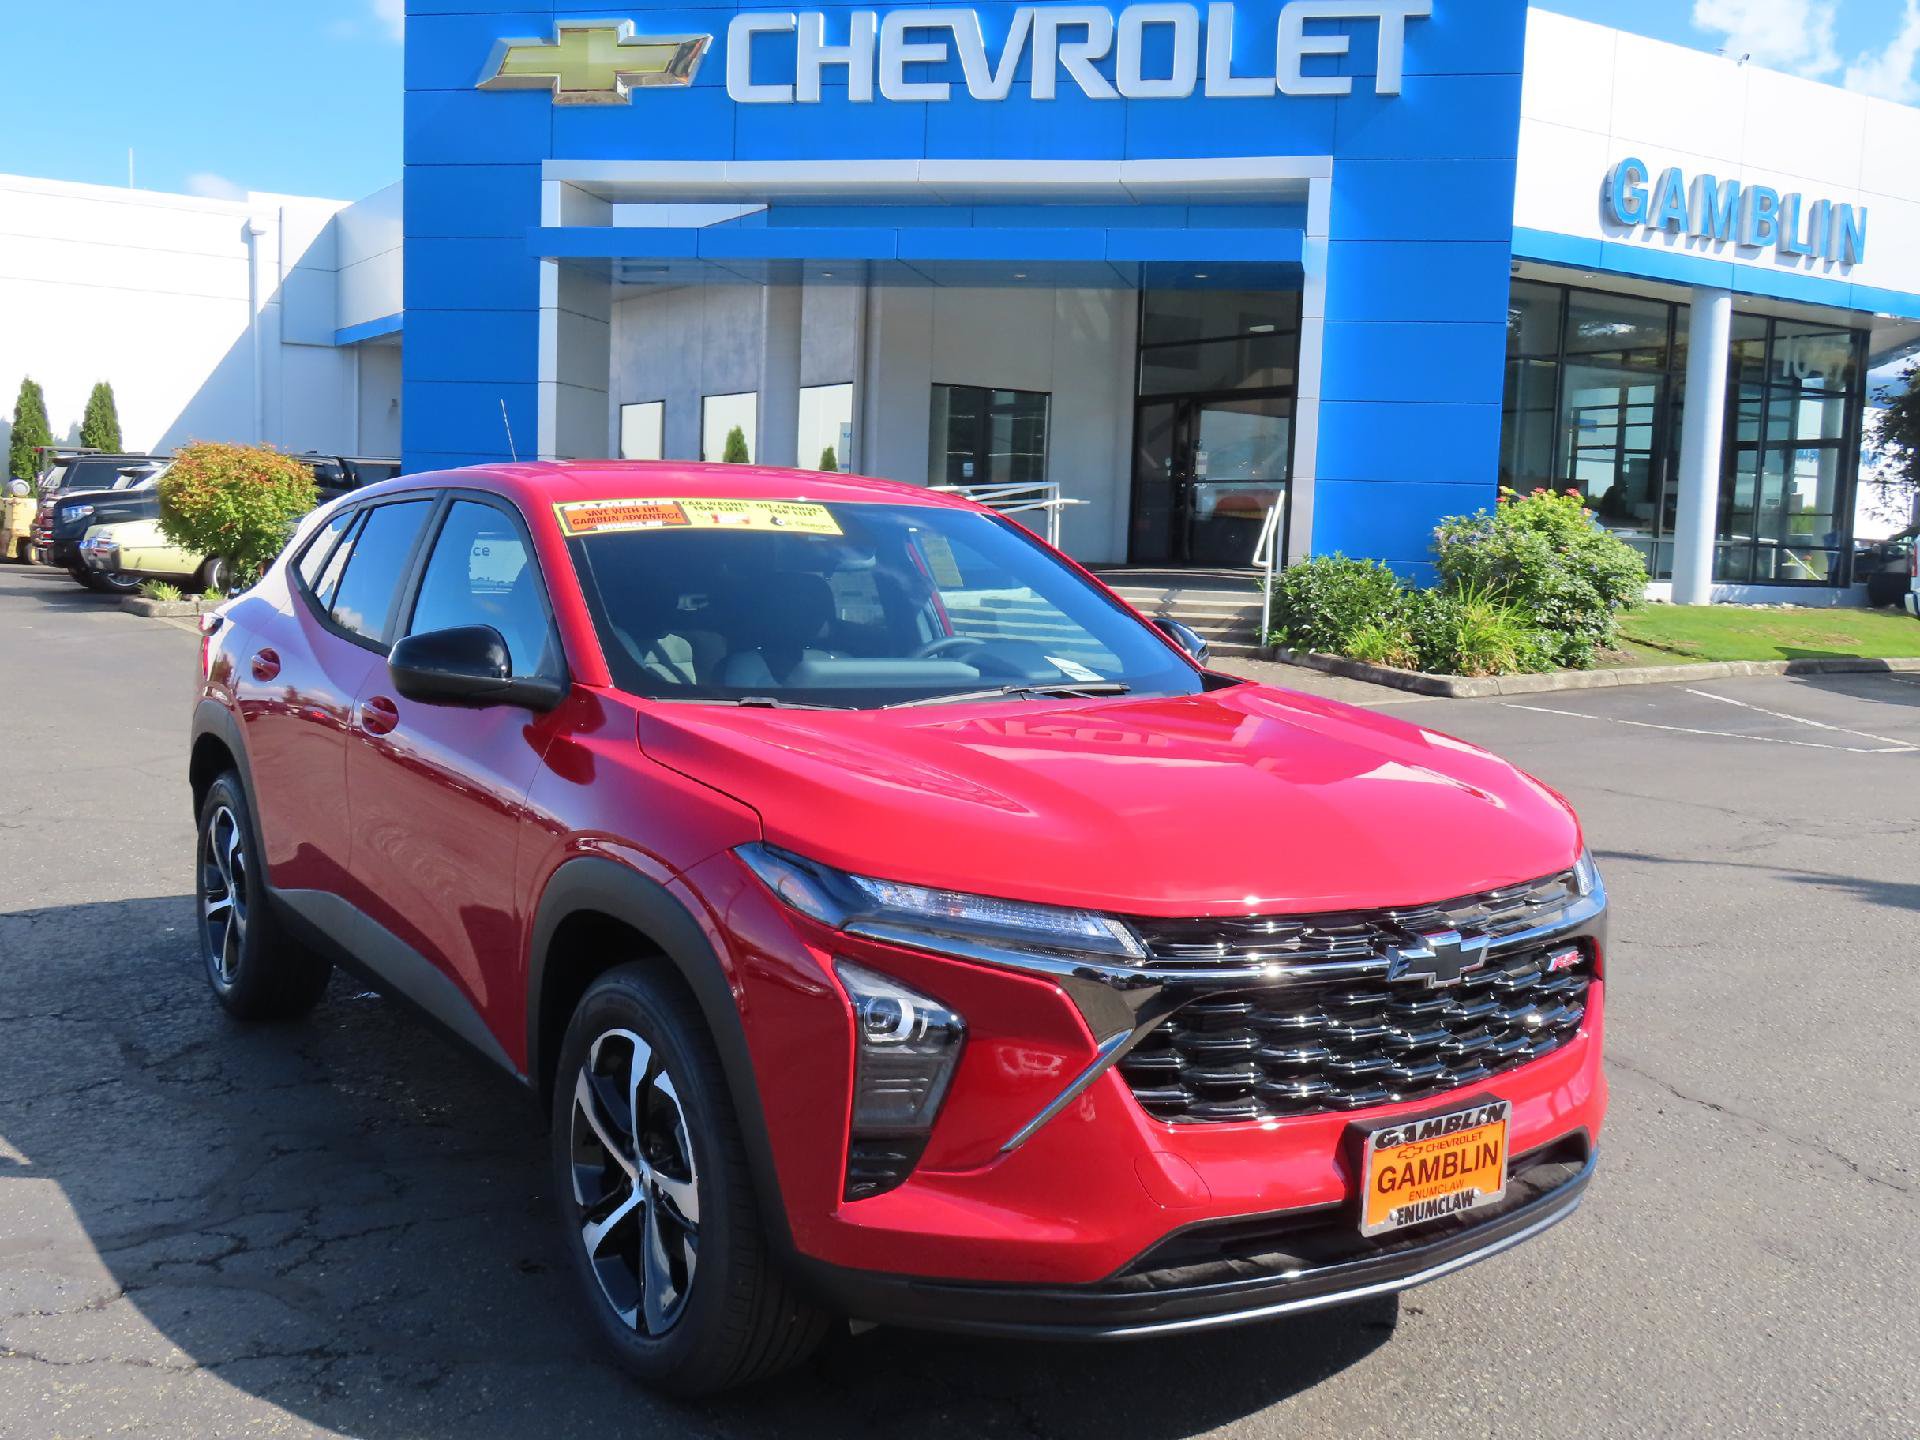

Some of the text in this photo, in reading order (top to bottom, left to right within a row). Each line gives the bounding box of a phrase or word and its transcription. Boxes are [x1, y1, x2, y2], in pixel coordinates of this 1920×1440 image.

[726, 0, 1433, 104] CHEVROLET
[1606, 157, 1868, 264] GAMBLIN
[571, 514, 620, 526] GAMBLIN
[621, 511, 682, 522] ADVANTAGE
[584, 508, 610, 517] SAVE
[612, 506, 639, 515] WITH
[1375, 1104, 1507, 1149] GAMBLIN
[1425, 1130, 1483, 1153] CHEVROLET
[1377, 1140, 1499, 1194] GAMBLIN
[1396, 1188, 1475, 1226] ENUMCLAW
[1408, 1179, 1465, 1202] ENUMCLAW
